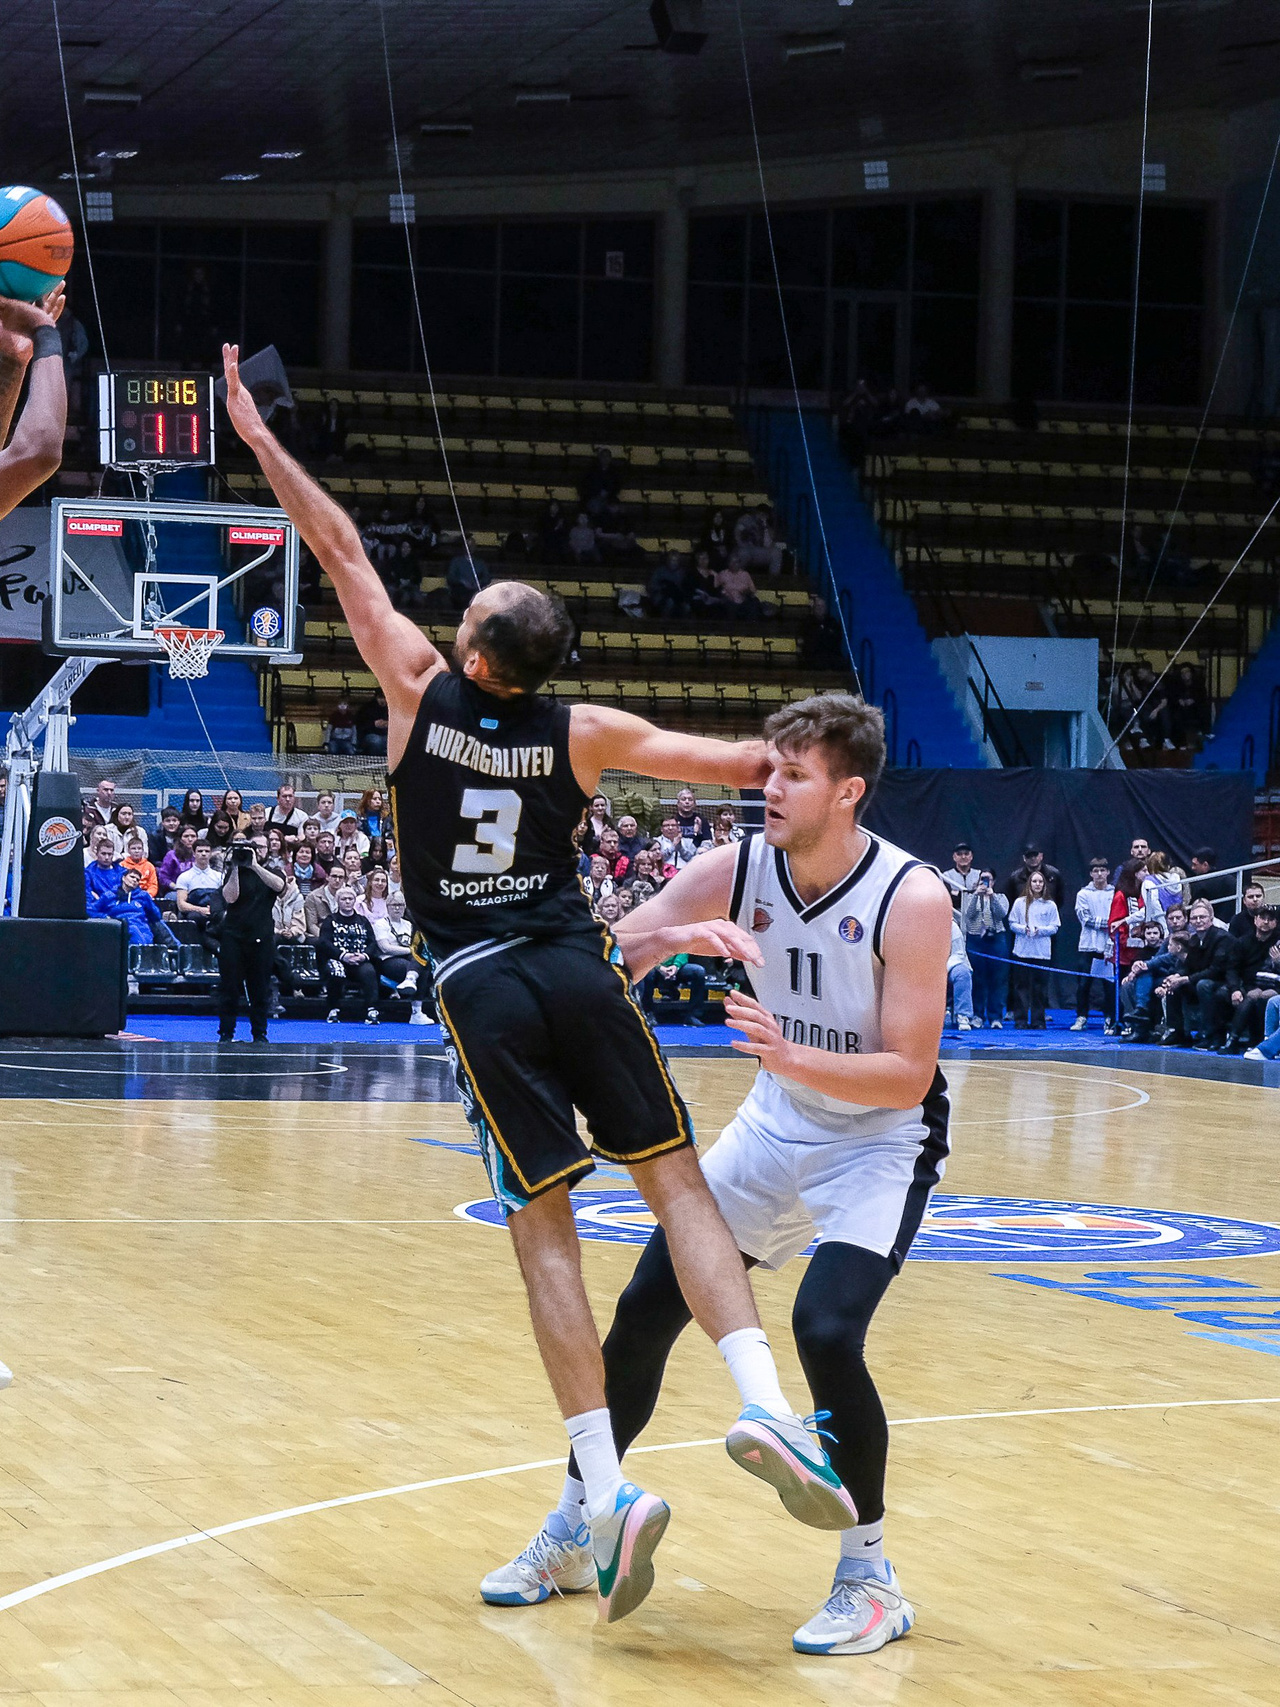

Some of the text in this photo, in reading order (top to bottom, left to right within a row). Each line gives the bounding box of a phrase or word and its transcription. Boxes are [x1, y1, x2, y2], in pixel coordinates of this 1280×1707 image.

[153, 380, 198, 405] 1:16
[69, 522, 121, 533] OLIMPBET
[231, 531, 282, 542] OLIMPBET
[425, 722, 554, 778] MURZAGALIYEV
[451, 788, 523, 875] 3
[439, 873, 549, 900] SportQory
[786, 946, 823, 1000] 11
